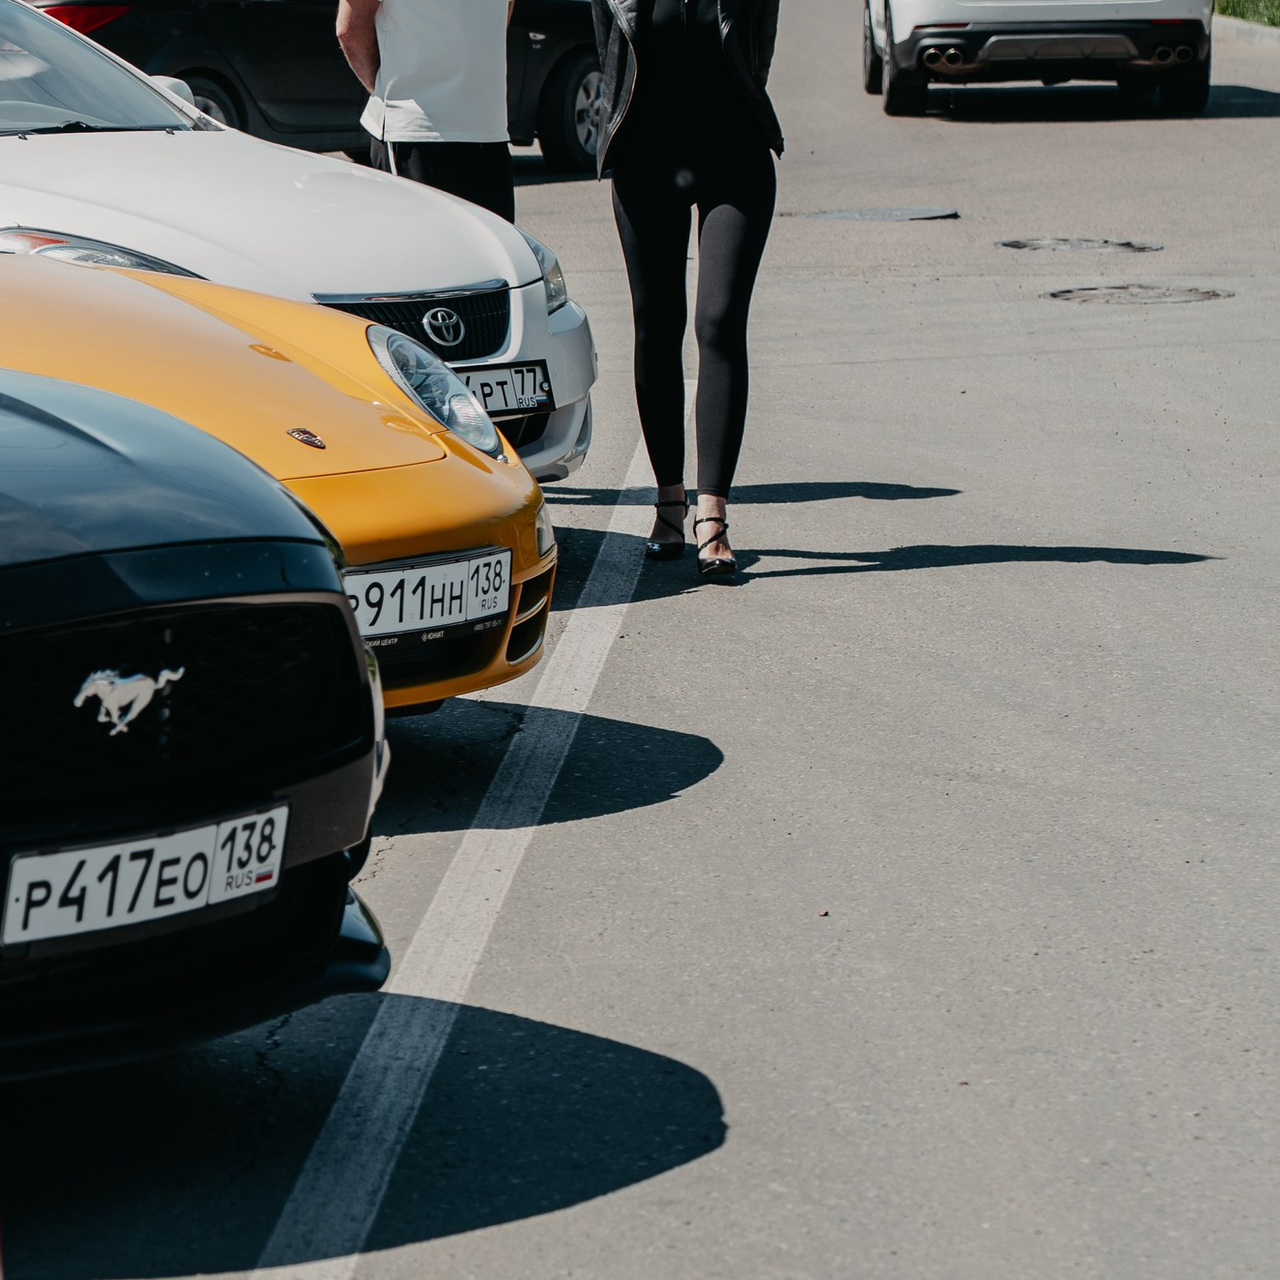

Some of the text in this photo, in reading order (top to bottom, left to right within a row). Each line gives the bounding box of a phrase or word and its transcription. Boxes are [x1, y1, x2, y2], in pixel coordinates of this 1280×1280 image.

[514, 367, 537, 396] 77
[518, 397, 537, 407] RUS
[470, 559, 503, 598] 138
[480, 596, 499, 611] RUS
[21, 817, 276, 931] Р417ЕО 138
[224, 869, 254, 892] RUS
